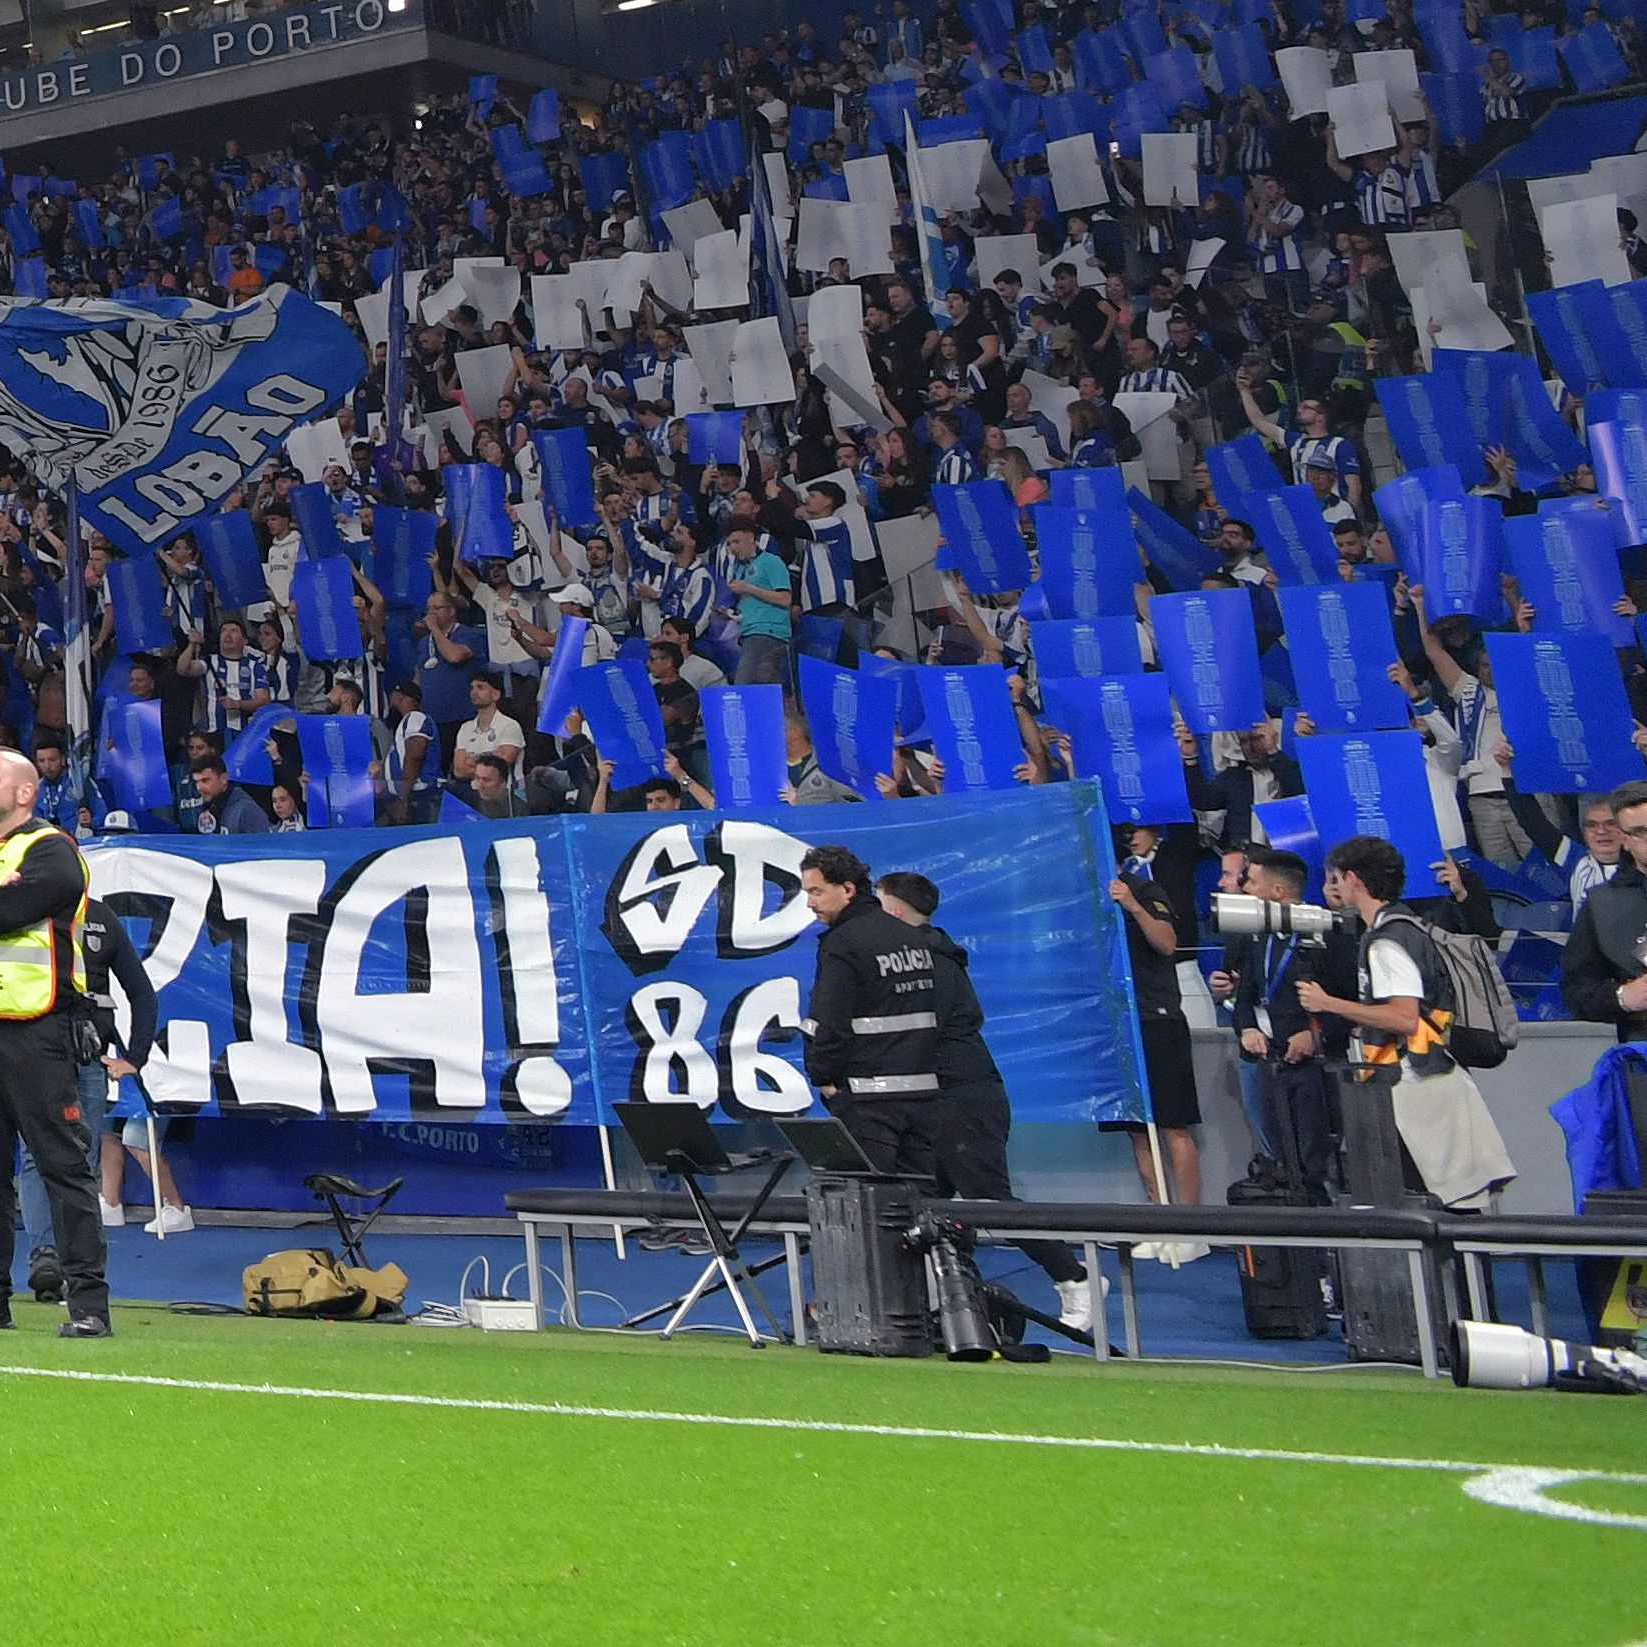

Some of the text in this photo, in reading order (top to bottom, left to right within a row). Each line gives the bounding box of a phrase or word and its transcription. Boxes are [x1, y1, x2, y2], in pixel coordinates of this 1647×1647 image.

[121, 44, 182, 86] DO
[98, 373, 327, 544] LOBÃO
[133, 364, 180, 429] 1986
[618, 820, 817, 954] SD
[629, 976, 815, 1114] 86
